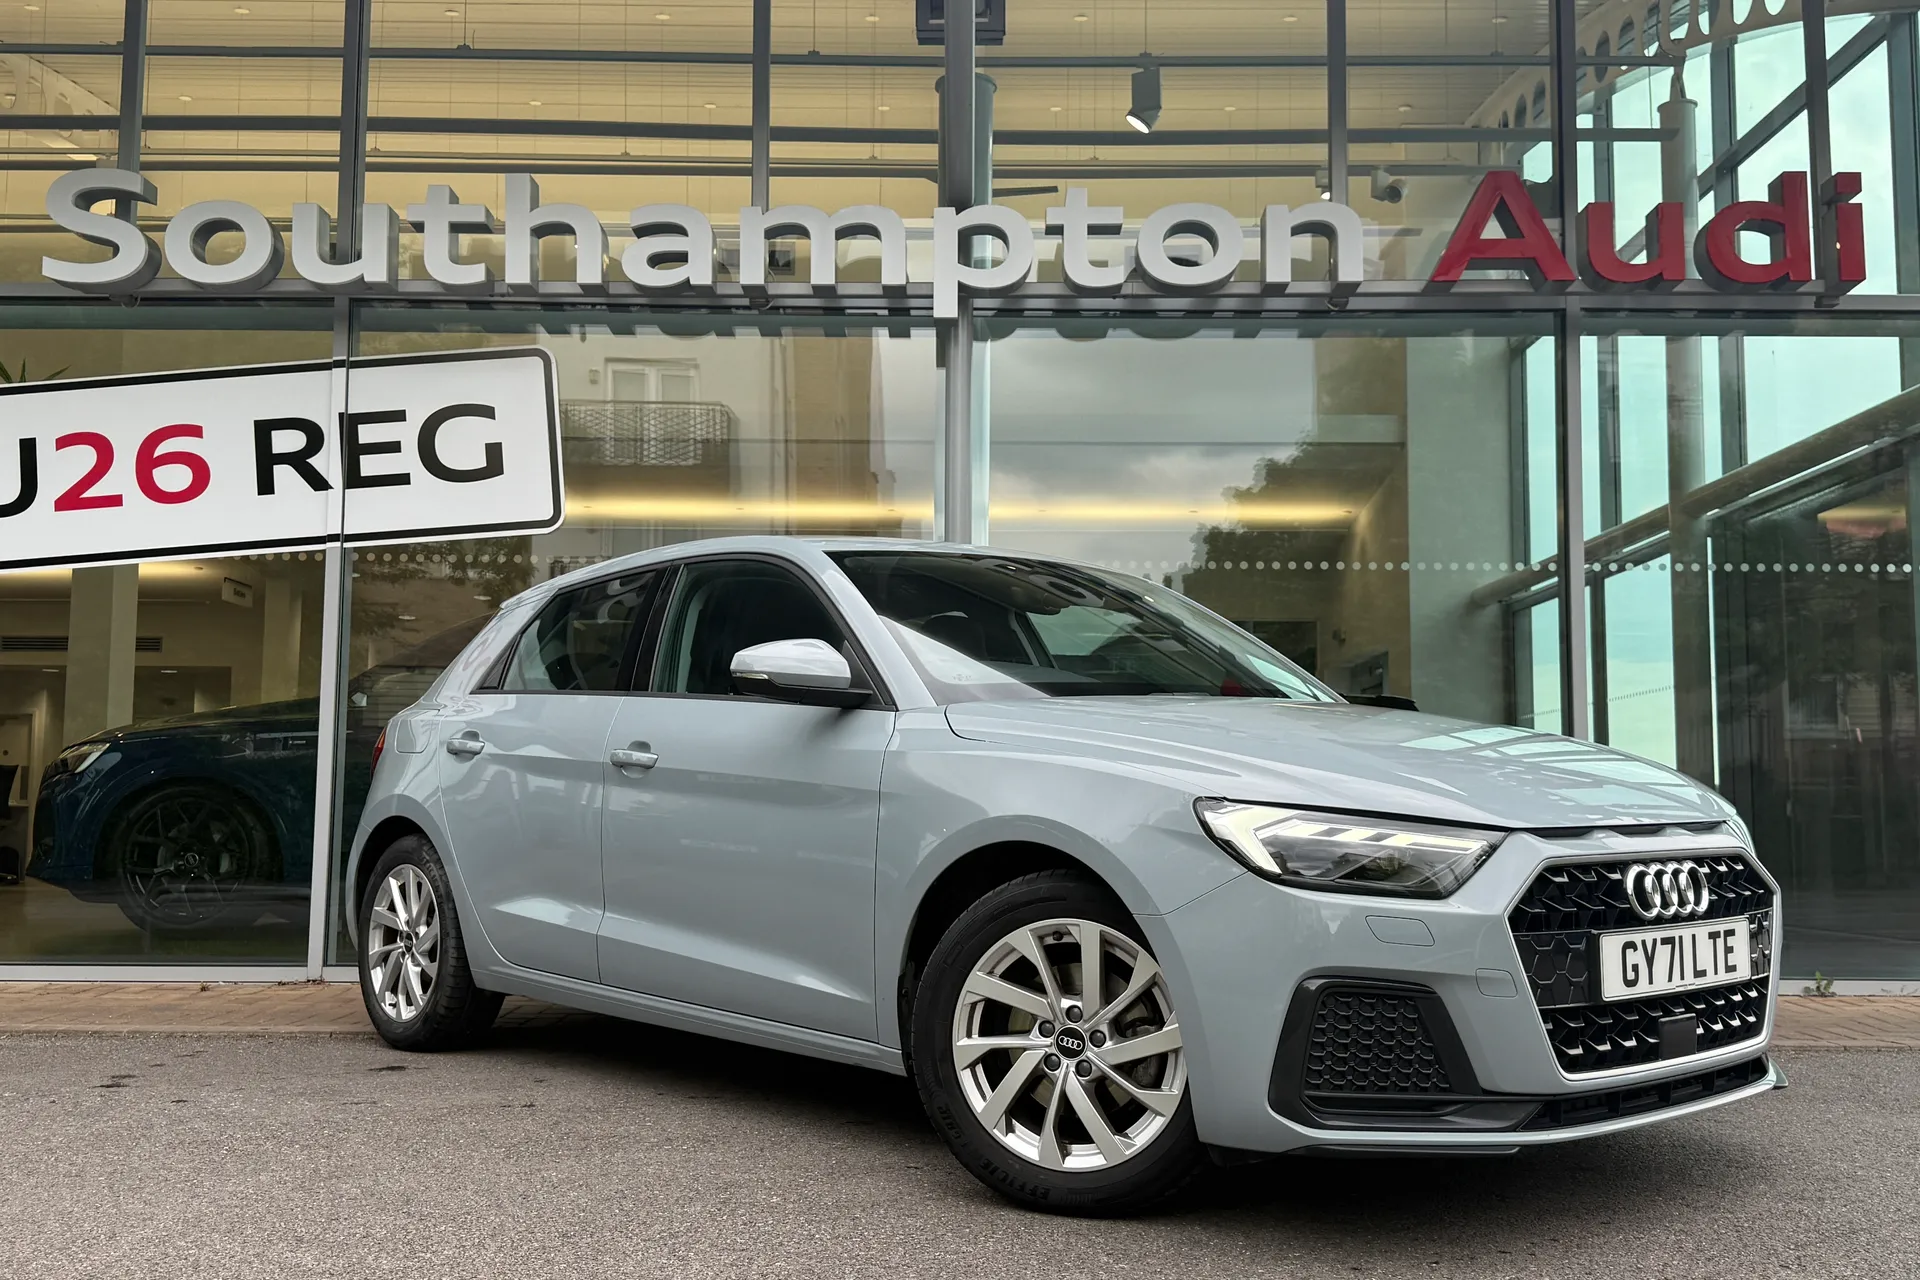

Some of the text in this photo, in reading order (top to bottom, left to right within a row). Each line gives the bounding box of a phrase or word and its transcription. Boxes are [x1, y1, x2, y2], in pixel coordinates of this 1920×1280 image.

[42, 168, 1867, 318] Southampton Audi
[254, 403, 505, 496] REG
[1621, 928, 1738, 988] GY71 LTE
